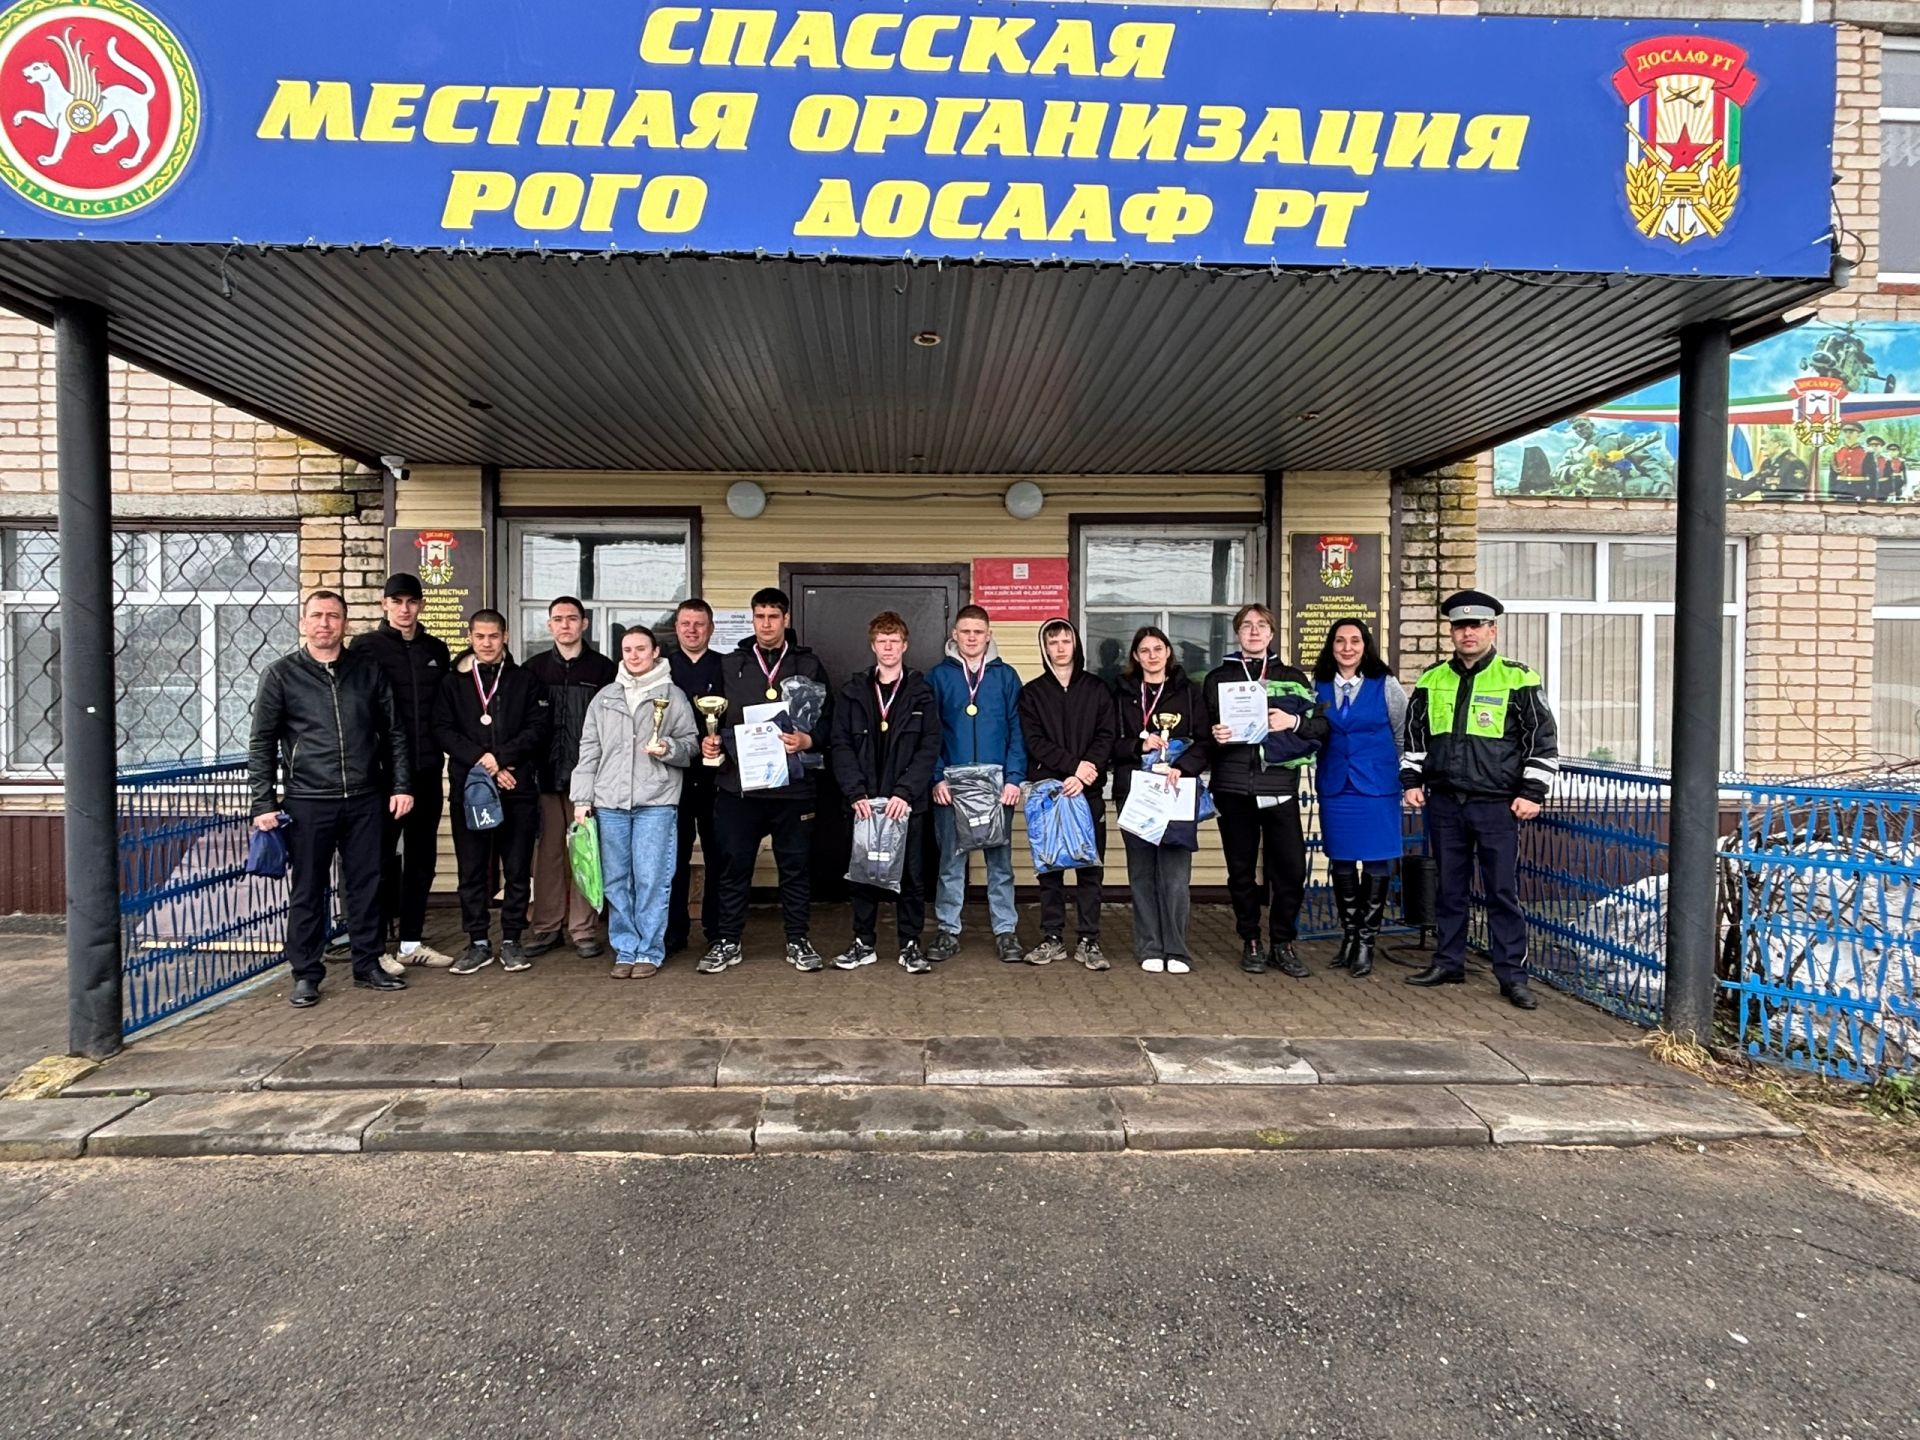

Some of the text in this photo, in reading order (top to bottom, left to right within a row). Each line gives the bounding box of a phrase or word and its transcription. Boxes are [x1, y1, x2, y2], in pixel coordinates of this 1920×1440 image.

[639, 7, 1176, 79] СПАССКАЯ
[1636, 49, 1737, 72] ДОСААФ РТ
[256, 79, 1531, 175] МЕСТНАЯ ОРГАНИЗАЦИЯ
[25, 182, 147, 214] ТАТАРСТАН
[441, 170, 1369, 247] РОГО ДОСААФ РТ
